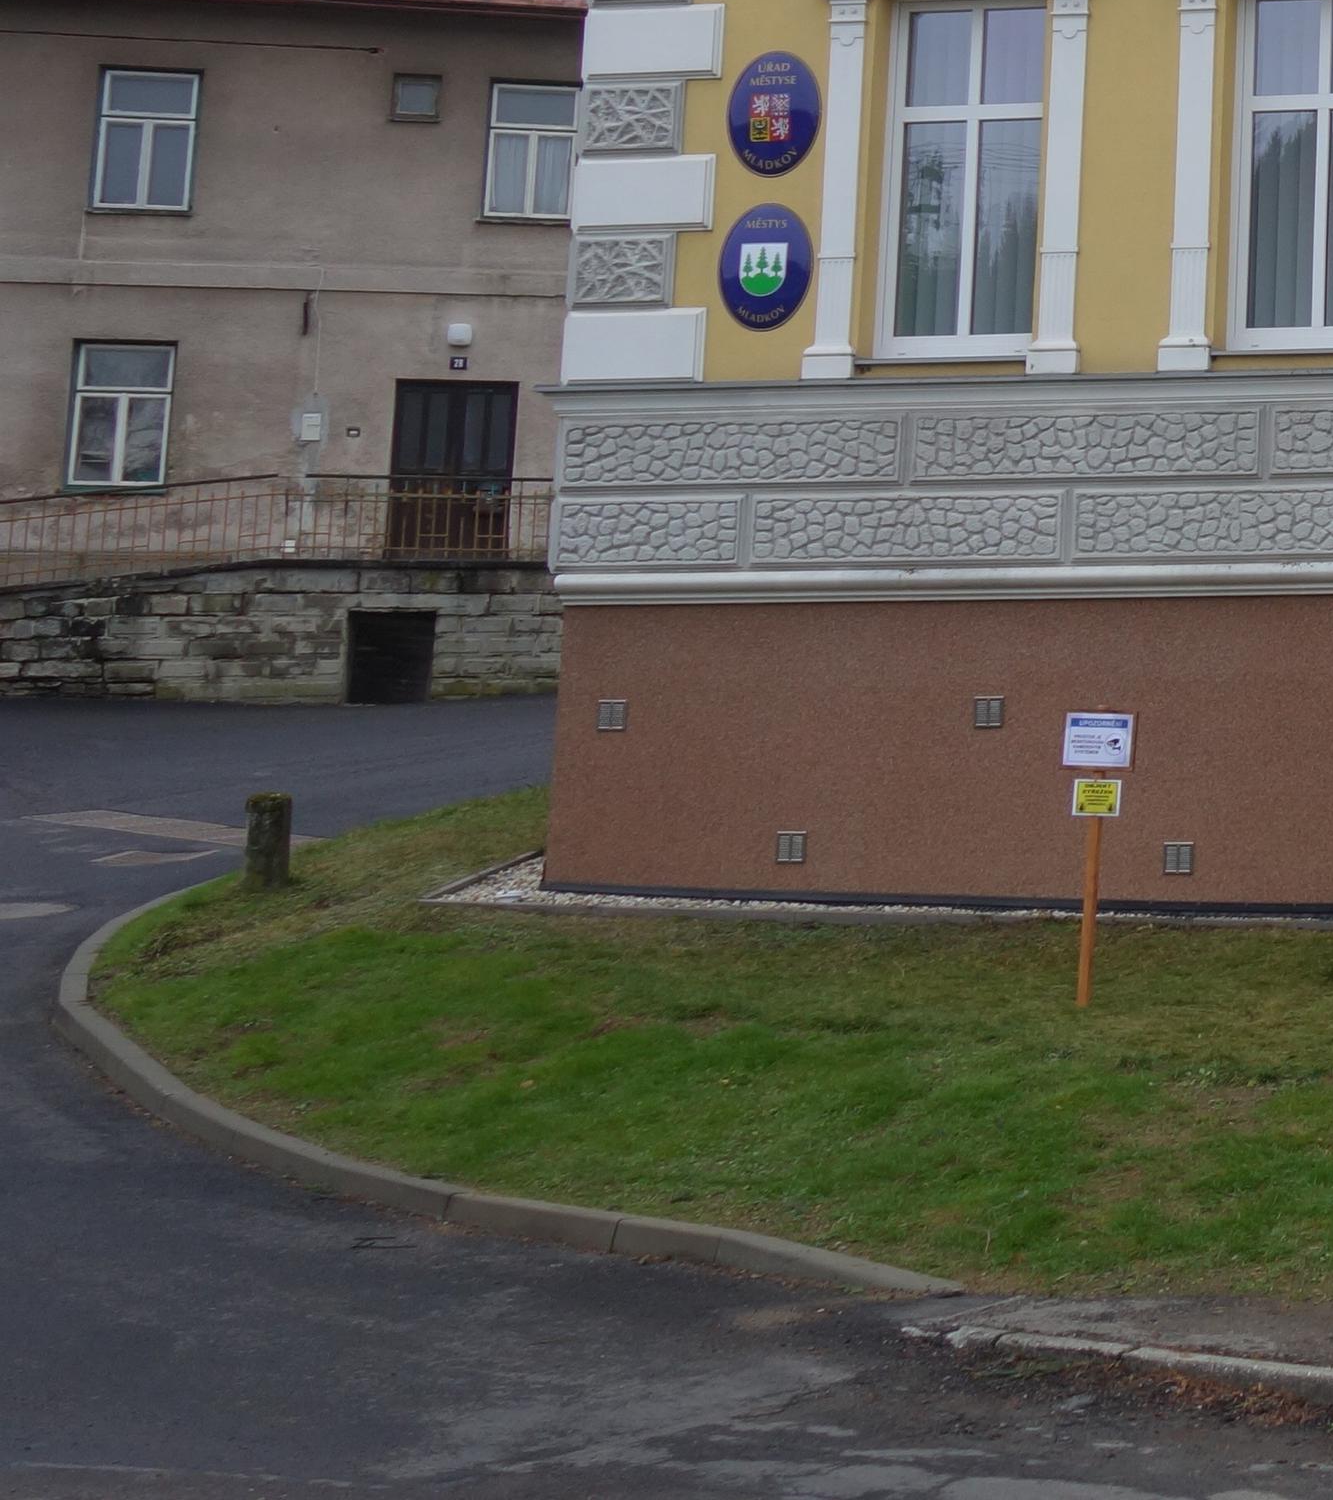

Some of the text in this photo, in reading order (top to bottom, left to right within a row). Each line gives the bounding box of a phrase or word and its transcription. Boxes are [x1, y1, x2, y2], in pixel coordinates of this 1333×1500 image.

[757, 61, 790, 73] ÚŘAD
[749, 75, 797, 86] MĚSTYSE
[744, 147, 797, 170] MLADKOV
[745, 218, 788, 229] MĚSTYS
[738, 304, 785, 323] MLADKOV
